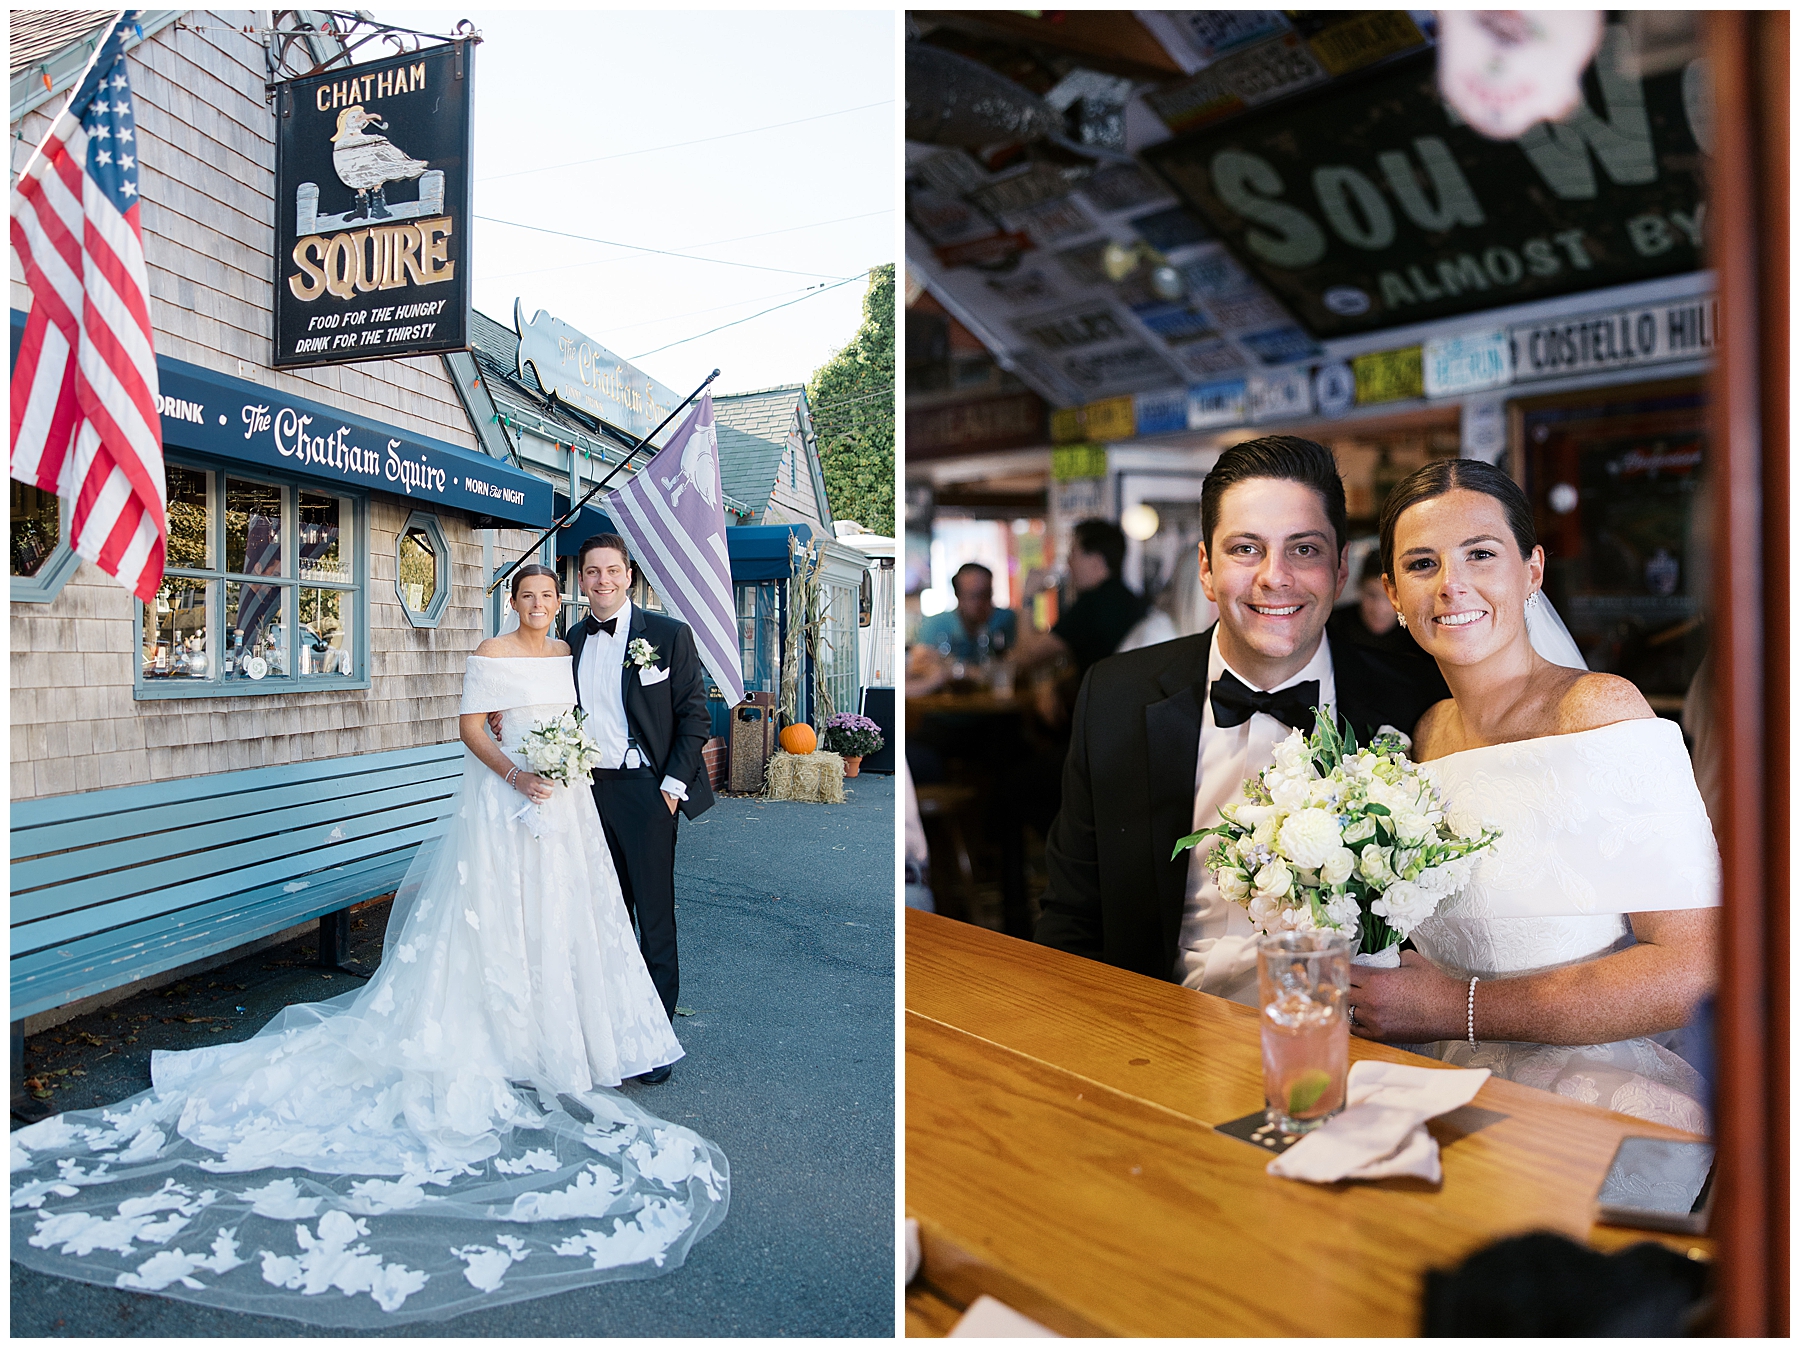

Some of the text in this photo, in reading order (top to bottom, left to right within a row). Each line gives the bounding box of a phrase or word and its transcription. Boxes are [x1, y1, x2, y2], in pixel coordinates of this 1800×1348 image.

[316, 62, 425, 111] CHATHAM
[288, 216, 454, 301] SQUIRE
[1379, 201, 1708, 308] ALMOST BY
[295, 322, 437, 353] DRINK FOR THE THIRSTY
[308, 299, 447, 332] FOOD FOR THE HUNGRY
[1529, 309, 1658, 371] COSTELLO
[558, 335, 576, 366] The
[578, 342, 643, 413] Chatham
[156, 393, 205, 426] DRINK
[241, 403, 272, 440] The
[273, 407, 380, 476] Chatham
[384, 438, 447, 495] Squire
[465, 476, 490, 497] MORN
[502, 487, 526, 506] NIGHT
